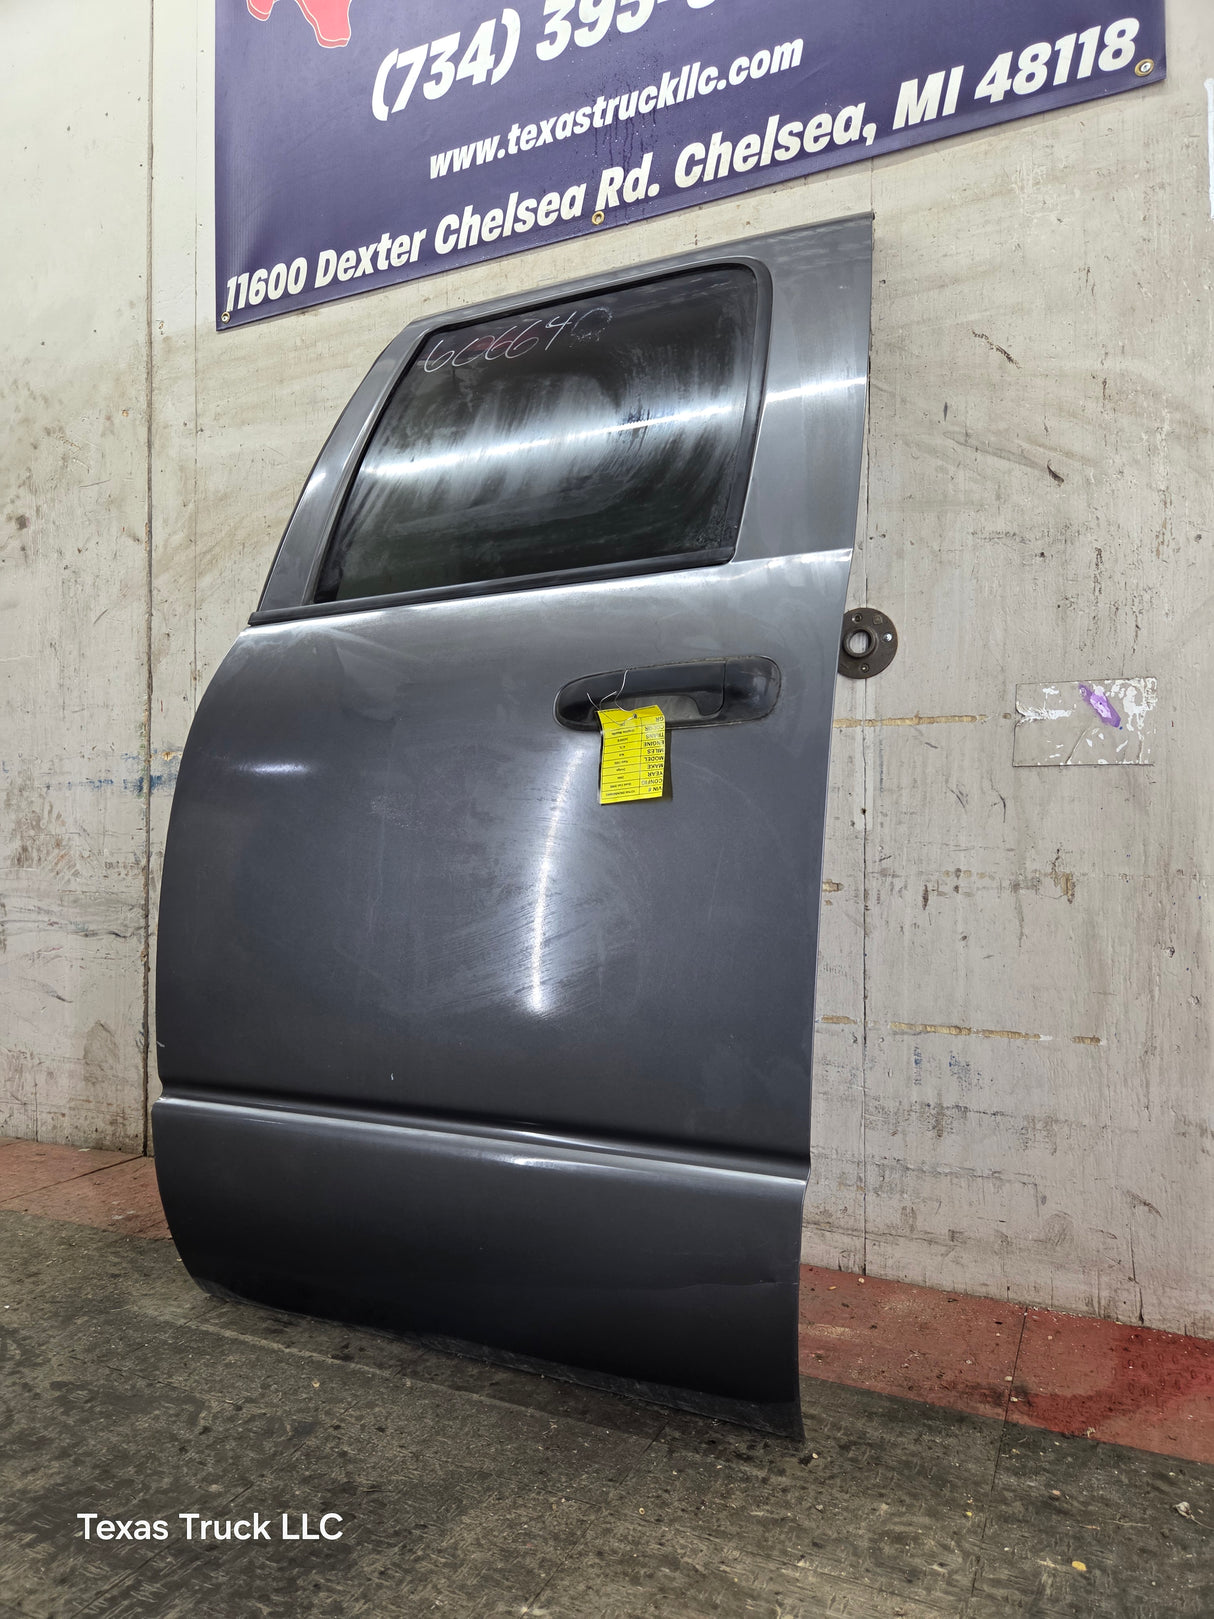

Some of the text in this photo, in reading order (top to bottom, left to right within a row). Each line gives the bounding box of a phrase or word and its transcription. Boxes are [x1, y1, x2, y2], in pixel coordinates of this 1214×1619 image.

[372, 0, 716, 121] (734) 395
[430, 38, 804, 179] www.texastruckllc.com
[226, 17, 1141, 312] 11600 Dexter Chelsea Rd. Chelsea, MI 48118
[647, 770, 663, 778] YEAR
